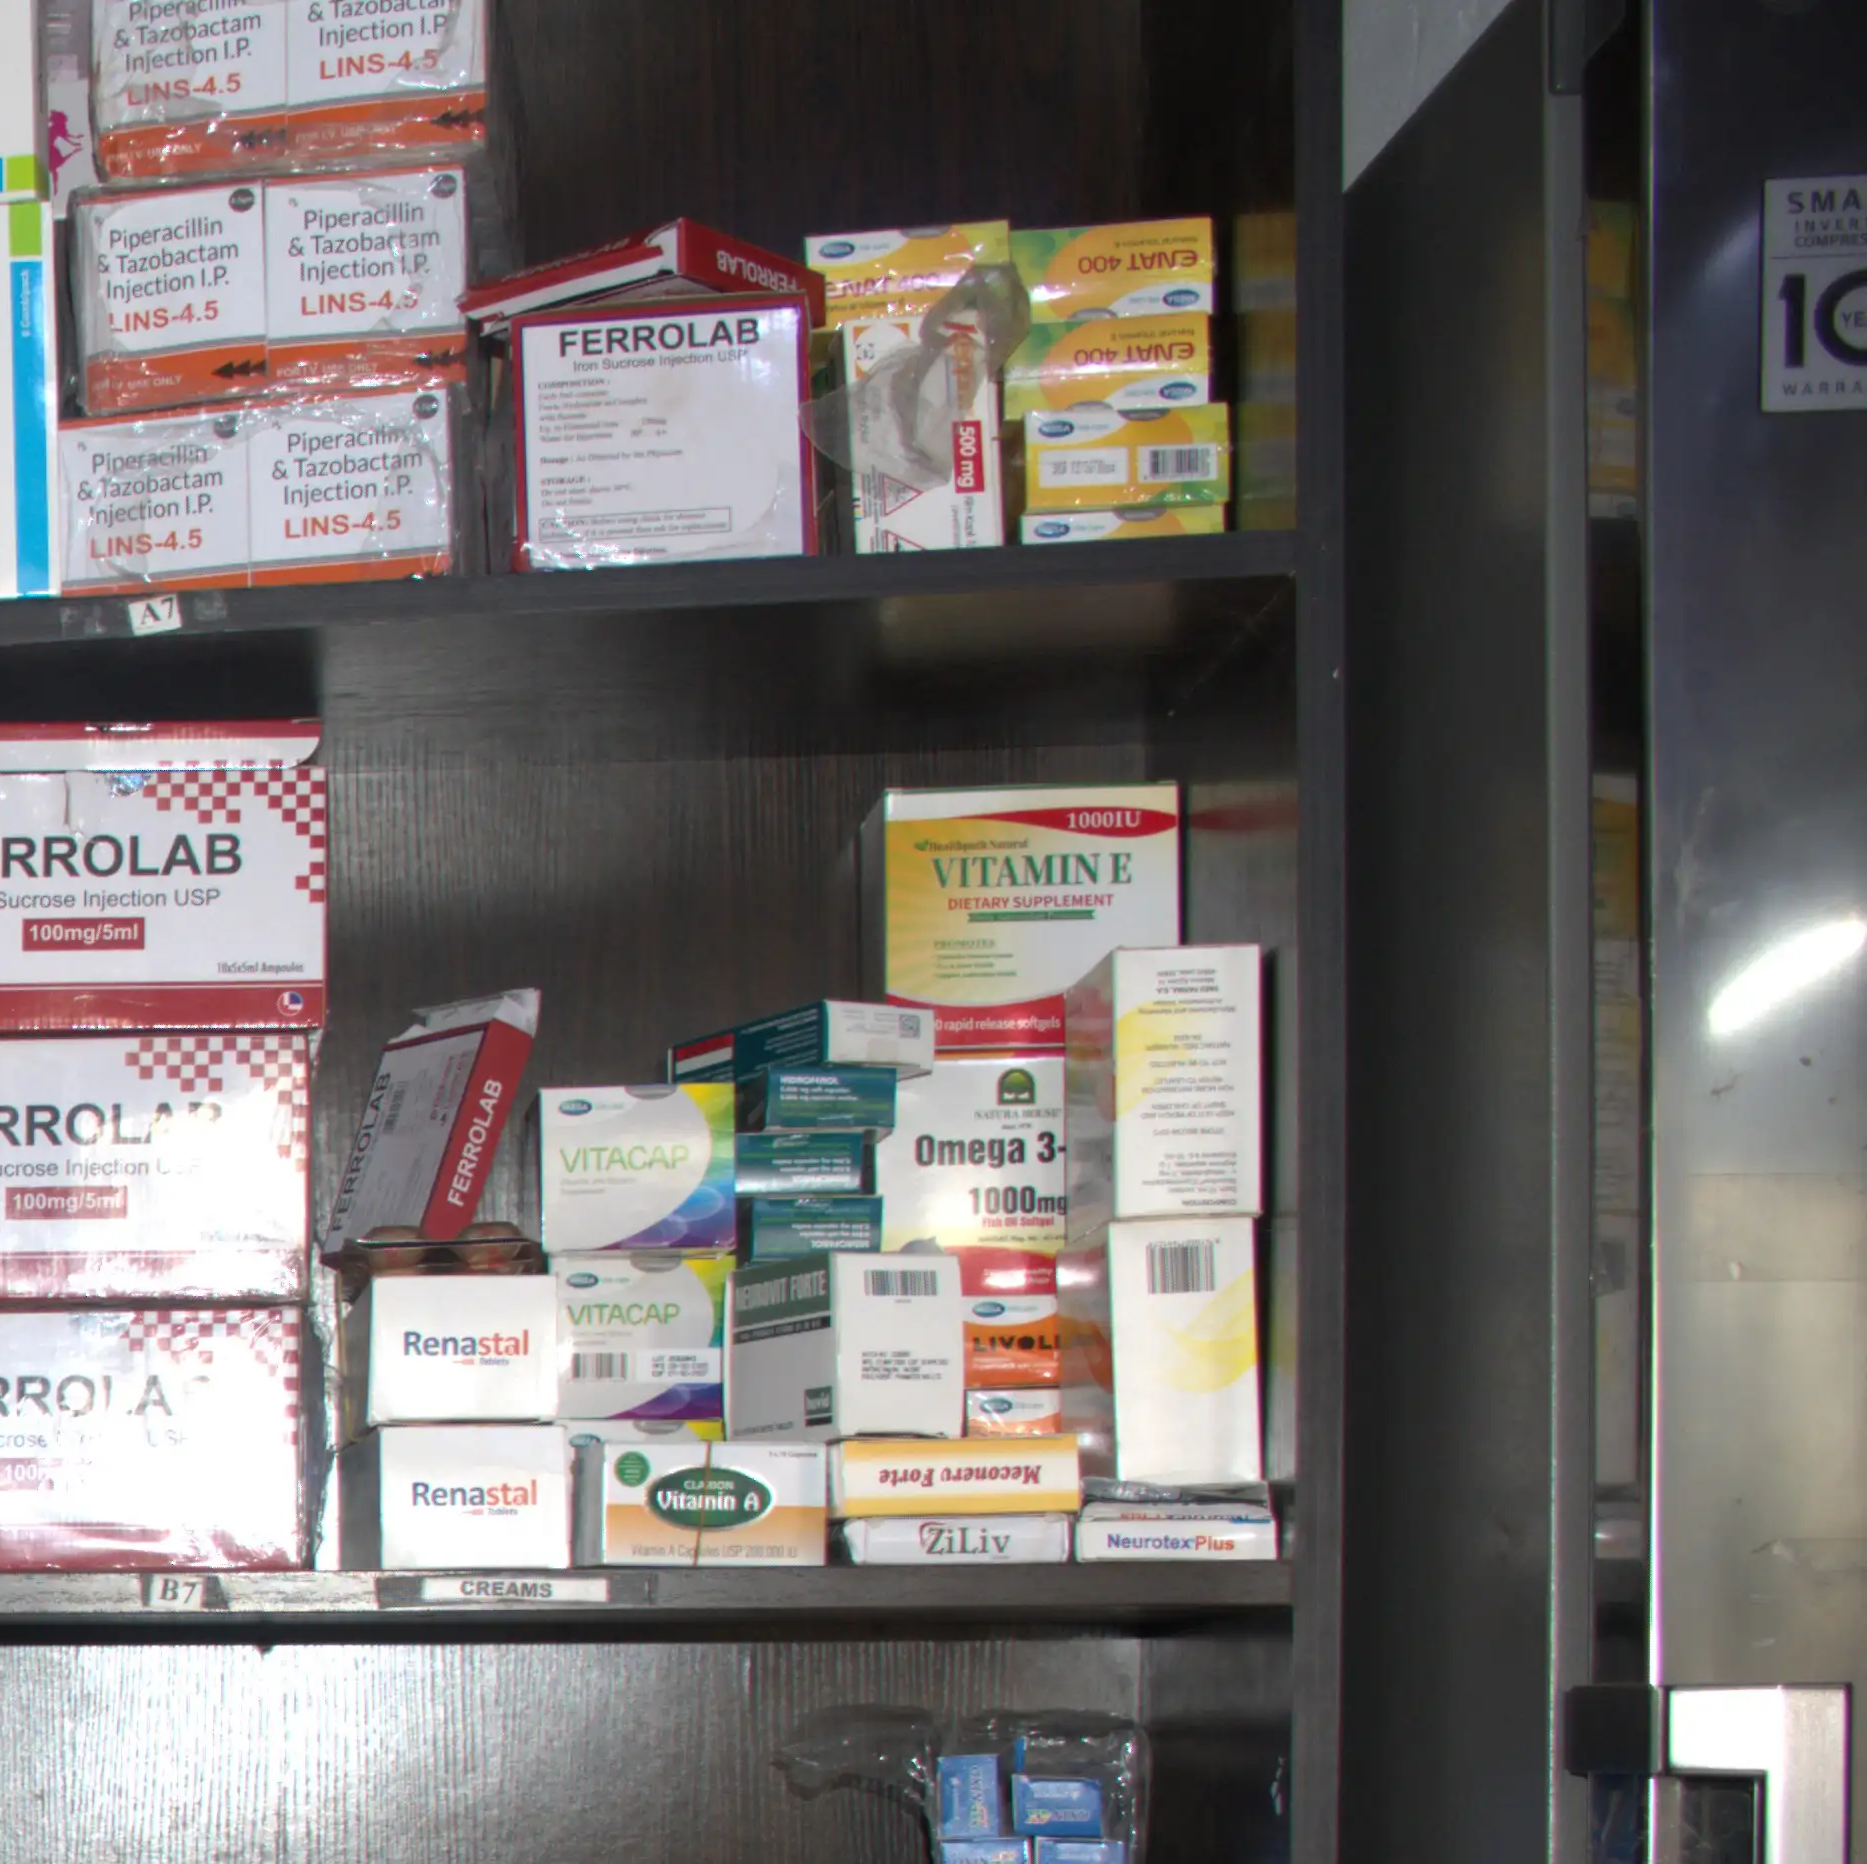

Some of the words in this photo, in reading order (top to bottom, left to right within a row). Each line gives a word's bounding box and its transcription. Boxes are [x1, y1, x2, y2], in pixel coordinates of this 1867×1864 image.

[126, 74, 241, 105] LINS-4.5
[303, 202, 424, 230] Piperacillin
[288, 236, 305, 256] &
[312, 227, 439, 253] Tazobactam
[299, 255, 395, 282] Injection
[1078, 252, 1121, 275] 400
[1123, 251, 1198, 272] ENAT
[300, 290, 418, 316] LINS-4.5
[109, 301, 219, 333] LINS-4.5
[559, 317, 760, 356] FERROLAB
[573, 357, 597, 373] Iron
[602, 355, 650, 372] Sucrose
[656, 351, 713, 369] Injection
[956, 424, 976, 459] 500
[956, 462, 976, 489] mg
[284, 511, 401, 539] LINS-4.5
[139, 598, 175, 623] A7
[1067, 811, 1141, 829] 1000IU
[931, 854, 1100, 889] VITAMIN
[1110, 853, 1132, 884] E
[82, 889, 167, 913] Injection
[173, 888, 221, 907] USP
[947, 894, 1010, 910] DIETARY
[1013, 894, 1114, 909] SUPPLEMENT
[27, 923, 140, 945] 100mg/5ml
[946, 1017, 972, 1032] rapid
[974, 1017, 1014, 1030] release
[1017, 1016, 1061, 1031] softgels
[448, 1079, 503, 1206] FERROLAB
[915, 1136, 1024, 1168] Omega
[560, 1145, 690, 1173] VITACAP
[404, 1329, 529, 1356] Renastal
[880, 1467, 933, 1487] Forte
[941, 1465, 1040, 1485] Meconerv
[657, 1490, 736, 1511] Vitamin
[743, 1493, 759, 1511] A
[1108, 1533, 1191, 1551] Neurotex
[1194, 1535, 1234, 1551] Plus
[158, 1578, 199, 1605] B7
[461, 1580, 553, 1598] CREAMS
